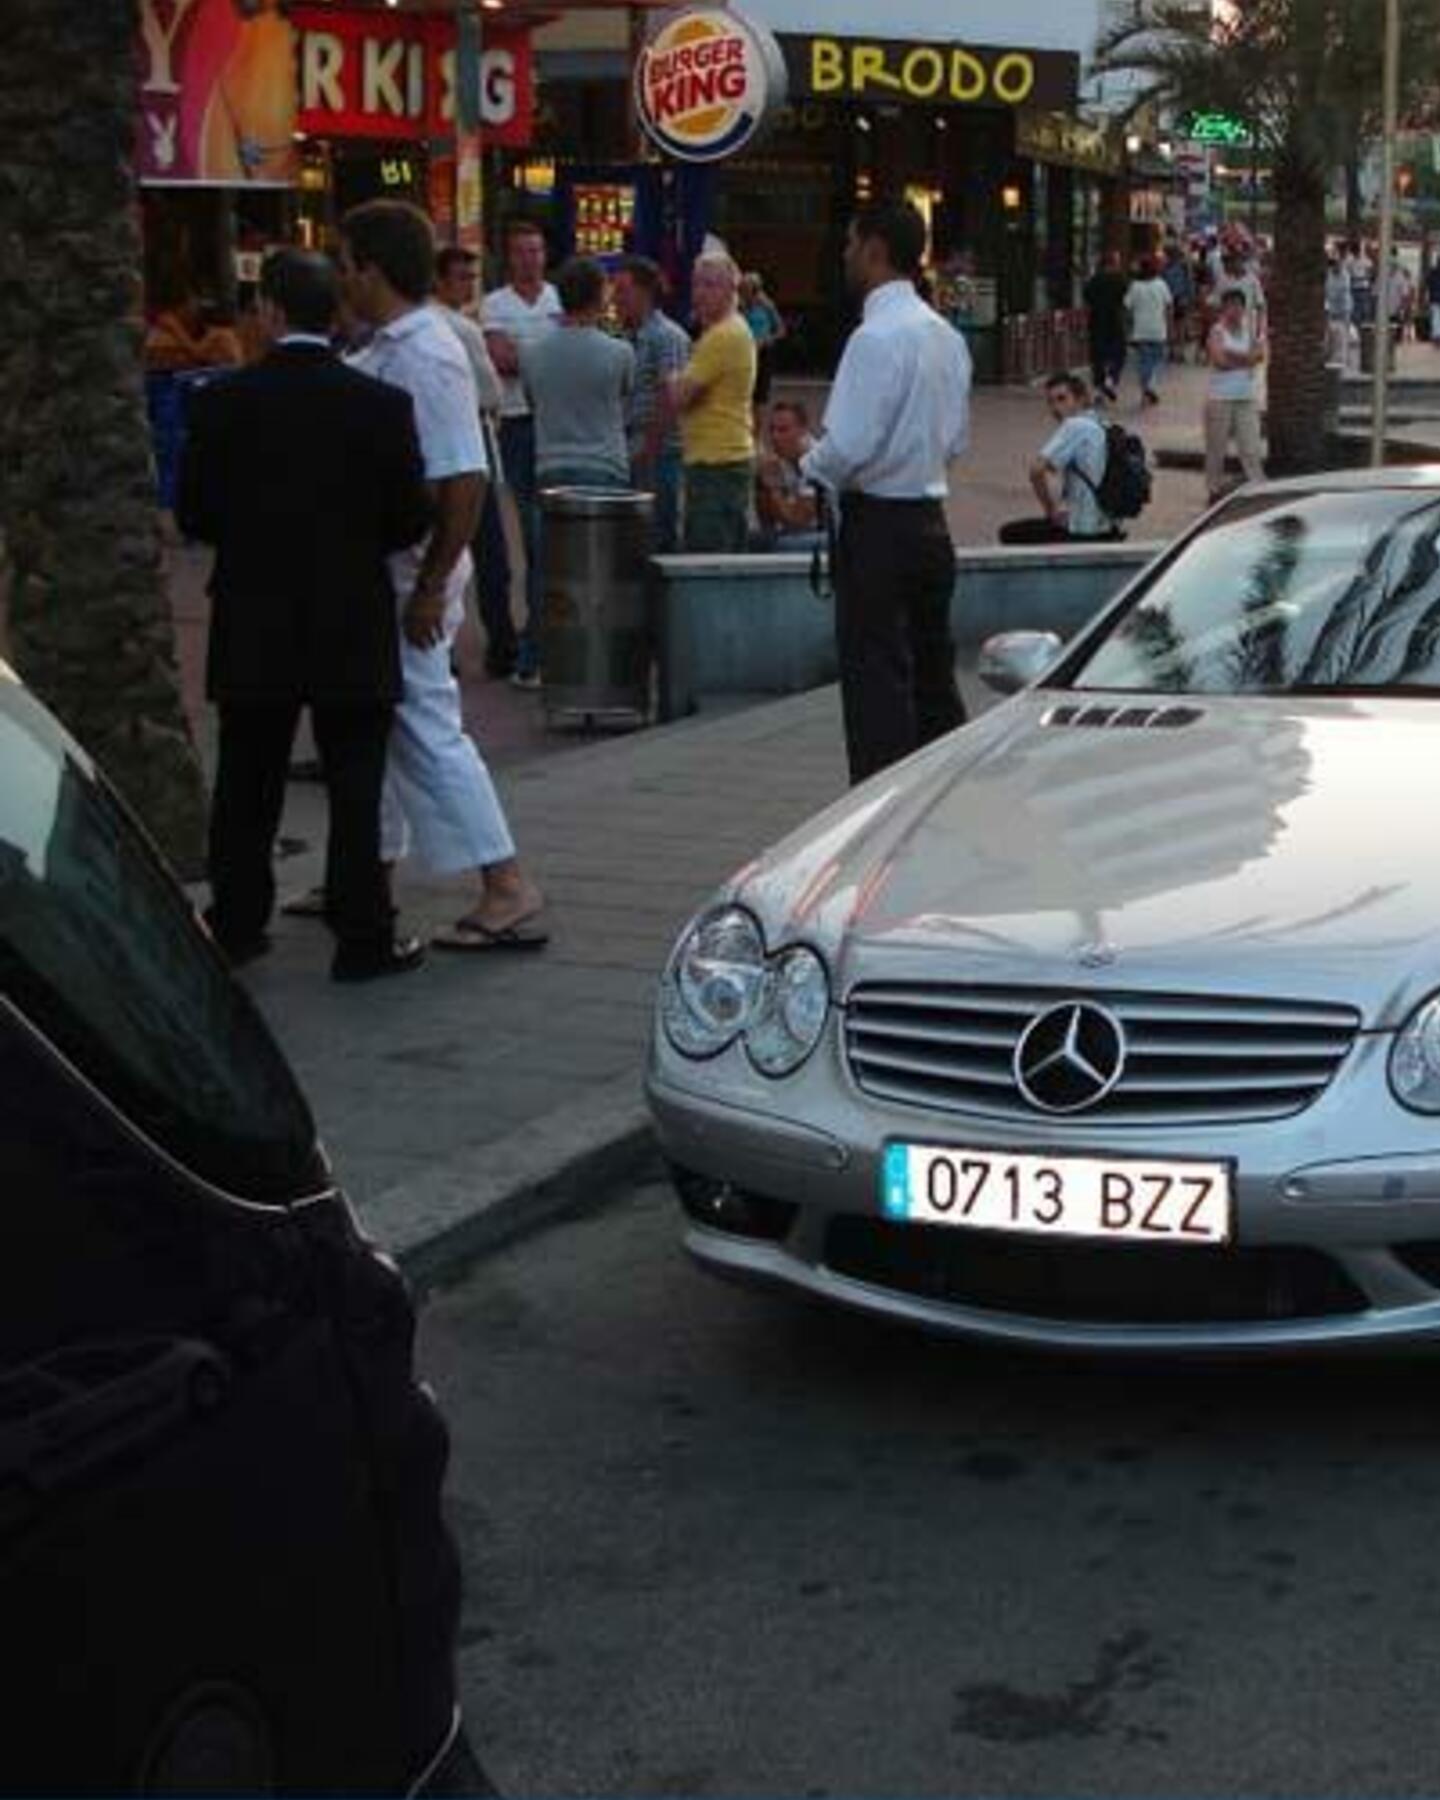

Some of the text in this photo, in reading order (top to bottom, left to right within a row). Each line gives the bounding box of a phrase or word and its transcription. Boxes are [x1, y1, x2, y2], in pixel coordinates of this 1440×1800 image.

[648, 38, 744, 84] BURGER
[811, 38, 1035, 102] BRODO
[653, 63, 747, 122] KING
[927, 1156, 1214, 1235] 0713 BZZ
